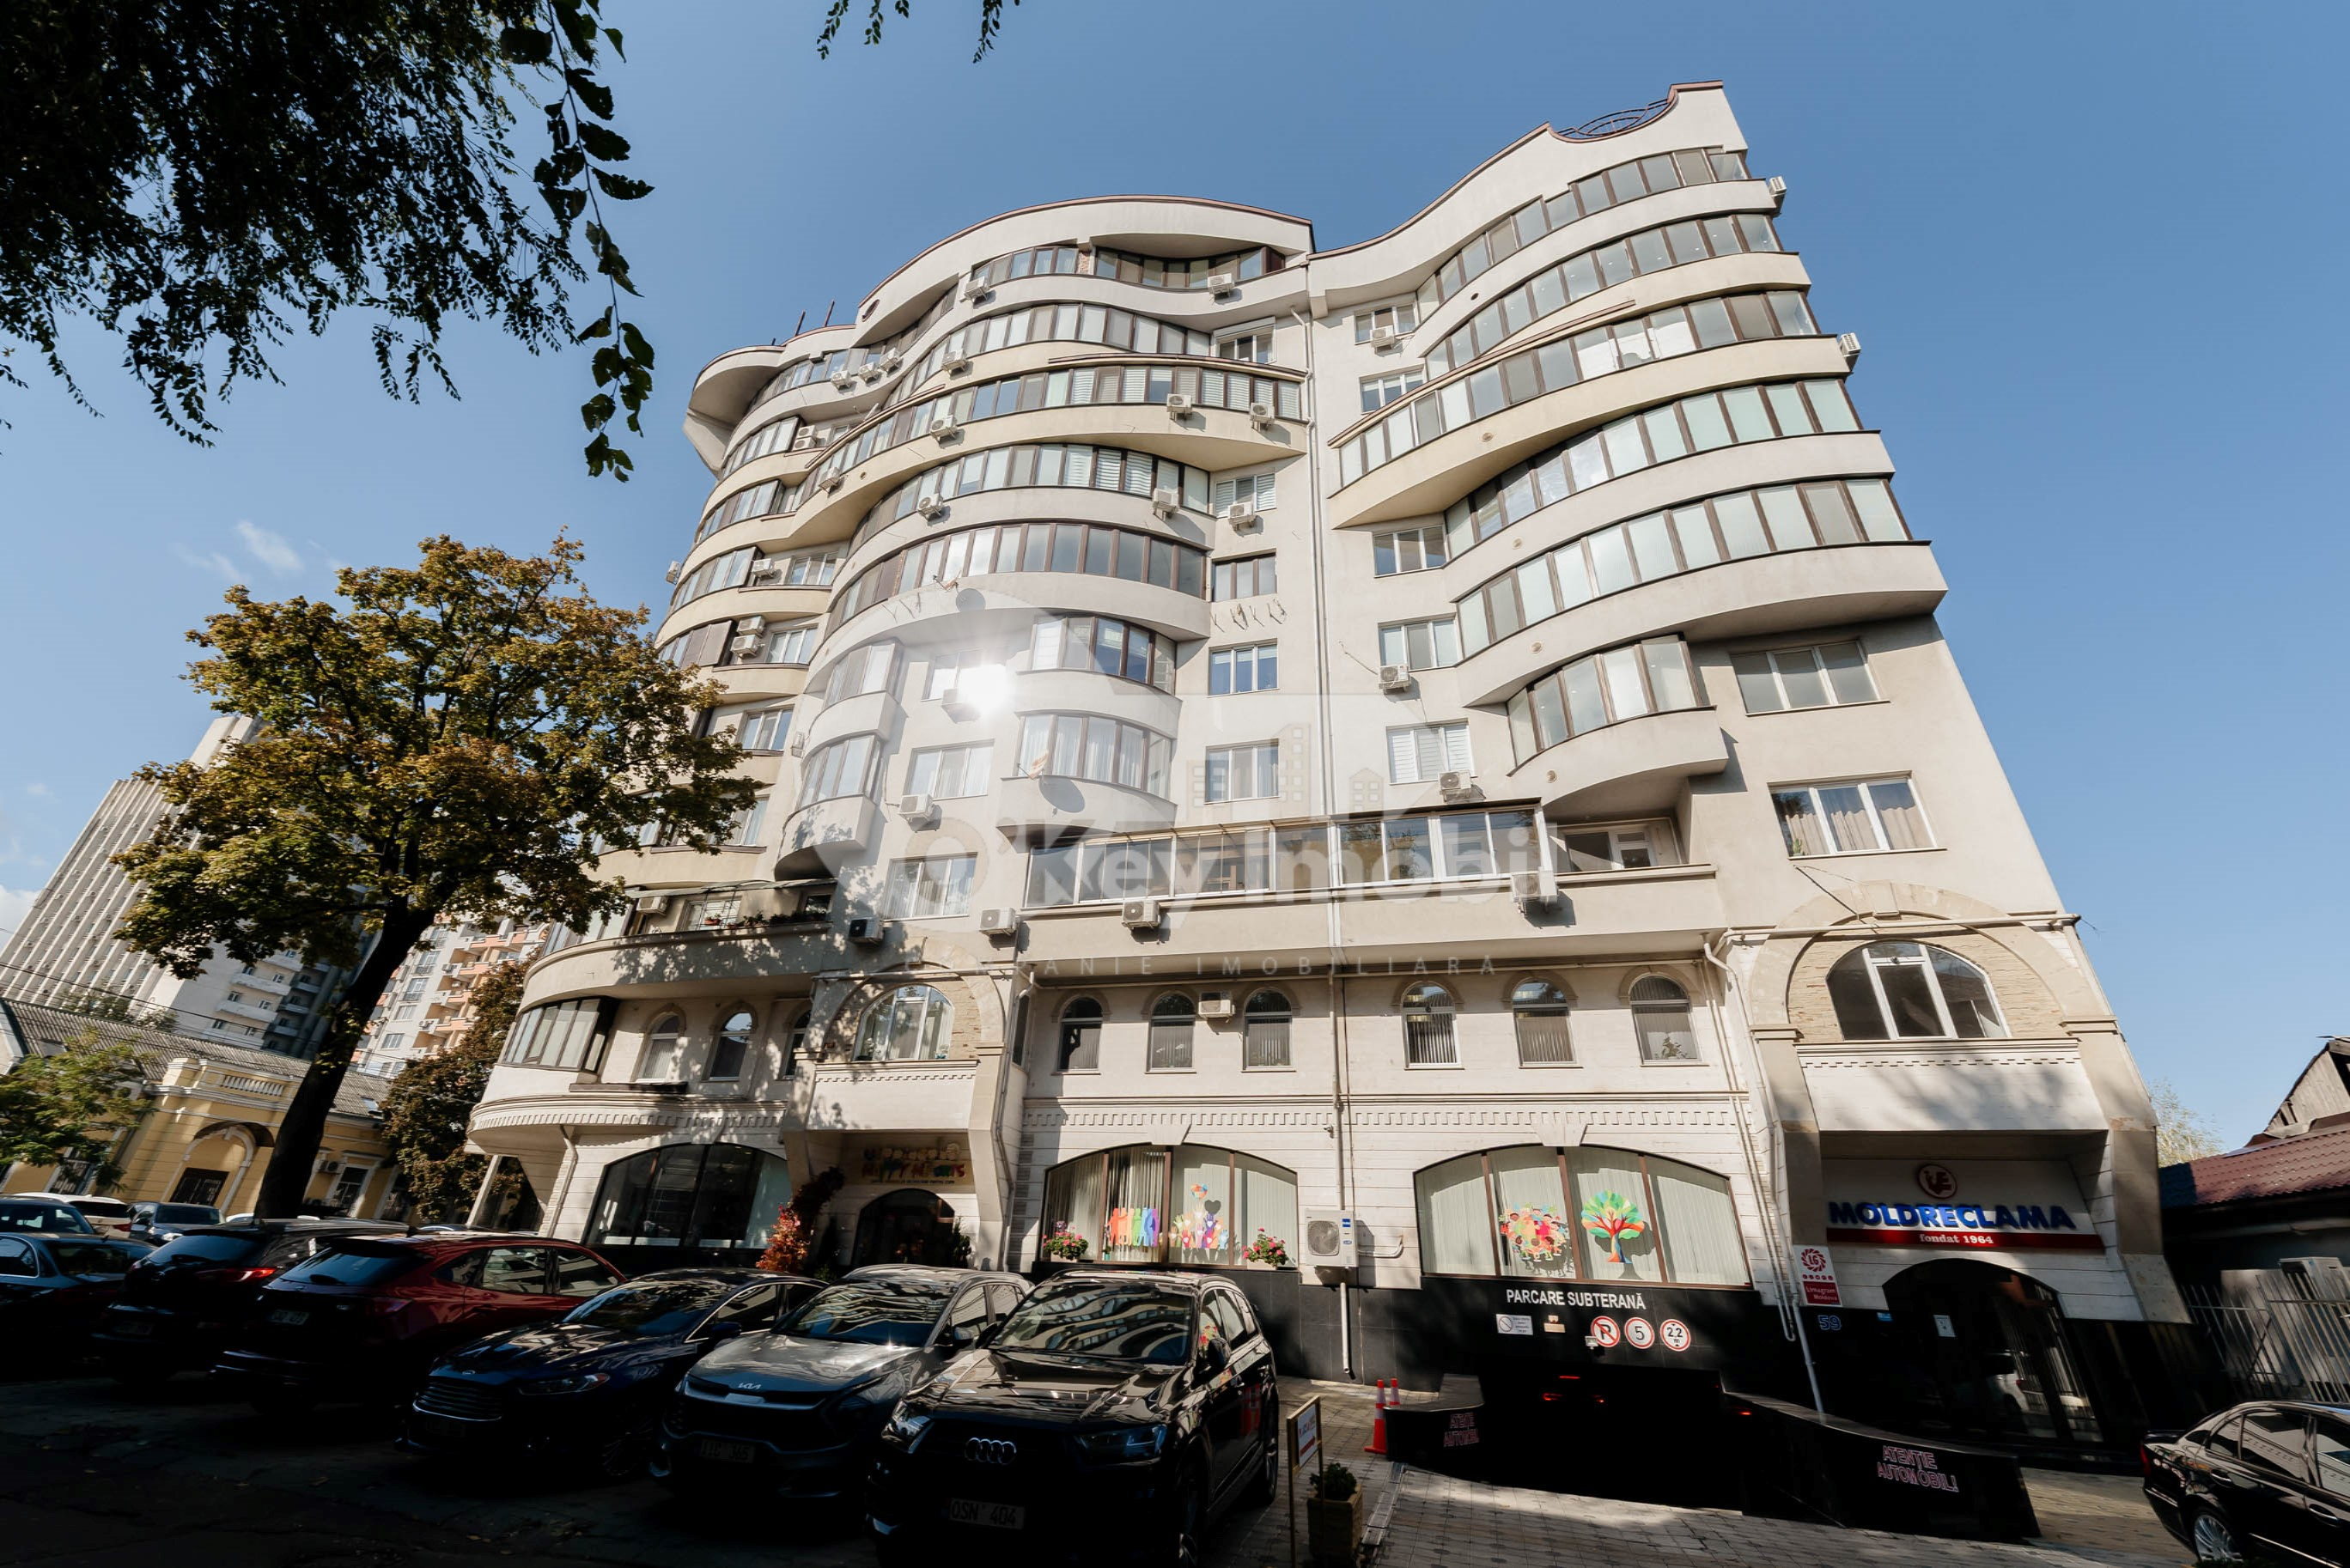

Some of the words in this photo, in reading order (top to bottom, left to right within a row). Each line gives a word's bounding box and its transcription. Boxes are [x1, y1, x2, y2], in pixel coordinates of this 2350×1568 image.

[1829, 1202, 2077, 1231] MOLDRECLAMA
[1919, 1233, 1960, 1243] fondat
[1963, 1235, 1994, 1244] 1964
[1506, 1289, 1566, 1305] PARCARE
[1568, 1291, 1647, 1310] SUBTERANĂ
[1817, 1315, 1842, 1331] 59
[1635, 1326, 1645, 1340] 5
[989, 1506, 1017, 1525] 404
